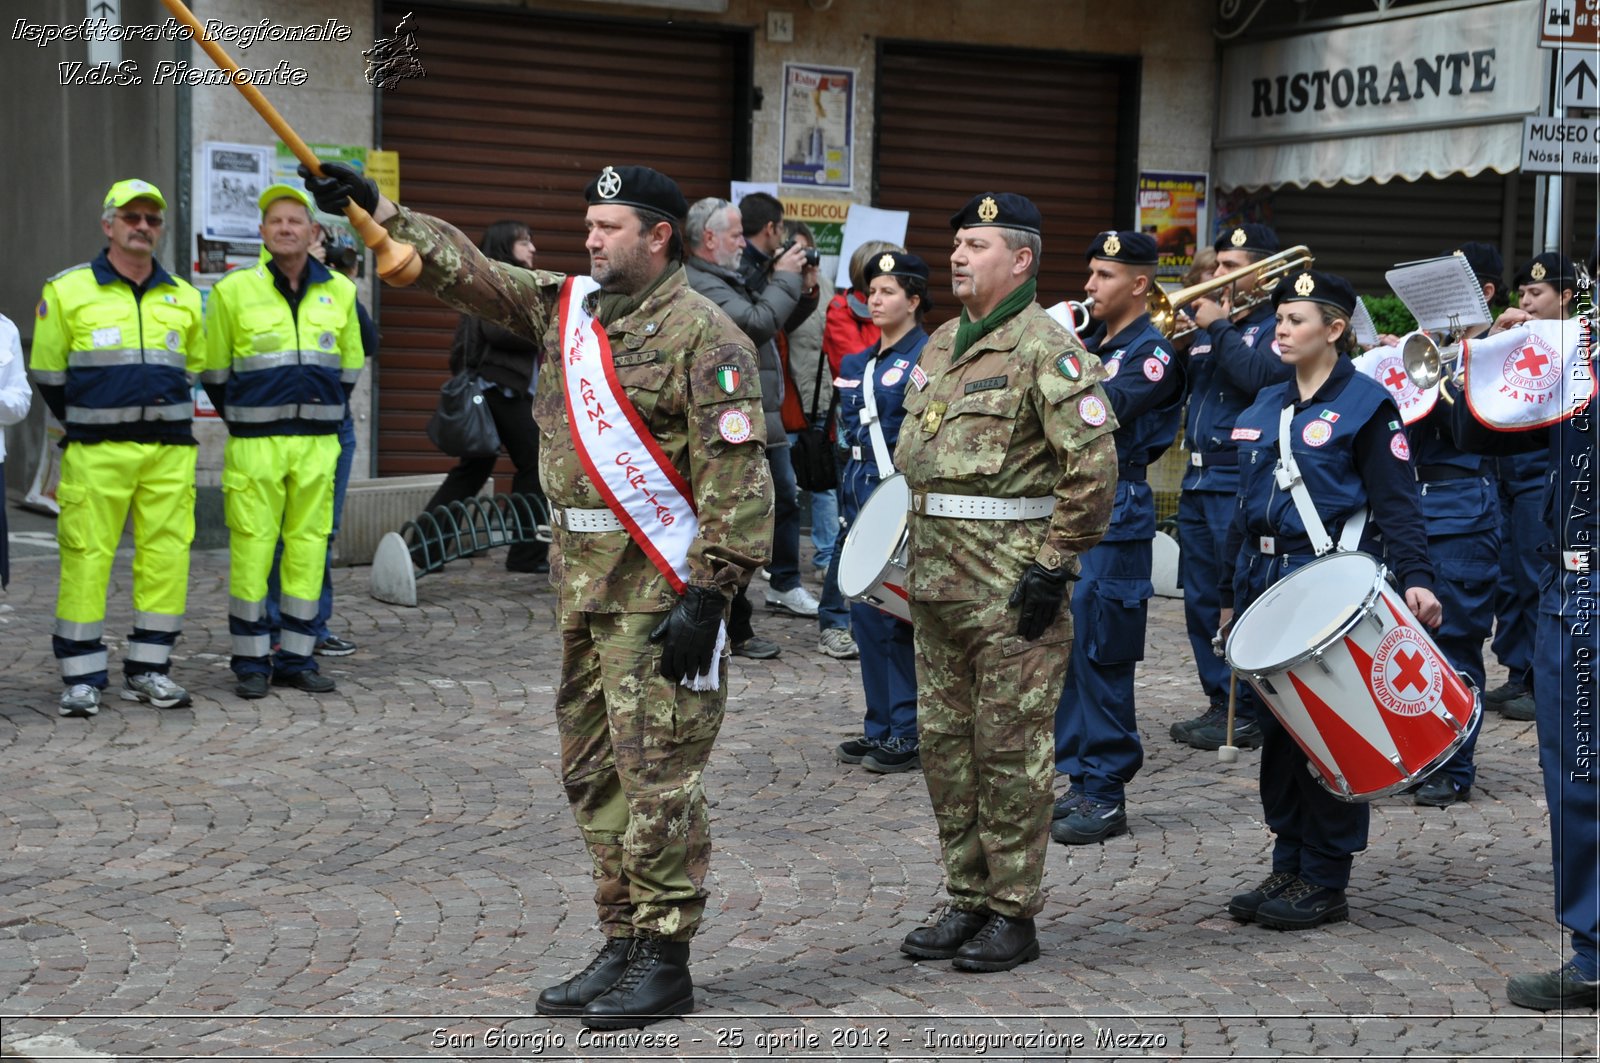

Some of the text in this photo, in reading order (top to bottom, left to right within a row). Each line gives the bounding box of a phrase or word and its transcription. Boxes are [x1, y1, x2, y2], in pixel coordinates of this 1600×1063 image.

[1251, 49, 1496, 118] RISTORANTE
[1530, 124, 1588, 142] MUSEO
[785, 203, 798, 215] IN
[972, 379, 1000, 390] MAZZA
[580, 377, 613, 436] ARMA
[615, 451, 676, 528] CARITAS
[1377, 628, 1405, 662] GINEVRA
[1374, 662, 1384, 673] DI
[1373, 675, 1427, 715] CONVENZIONE
